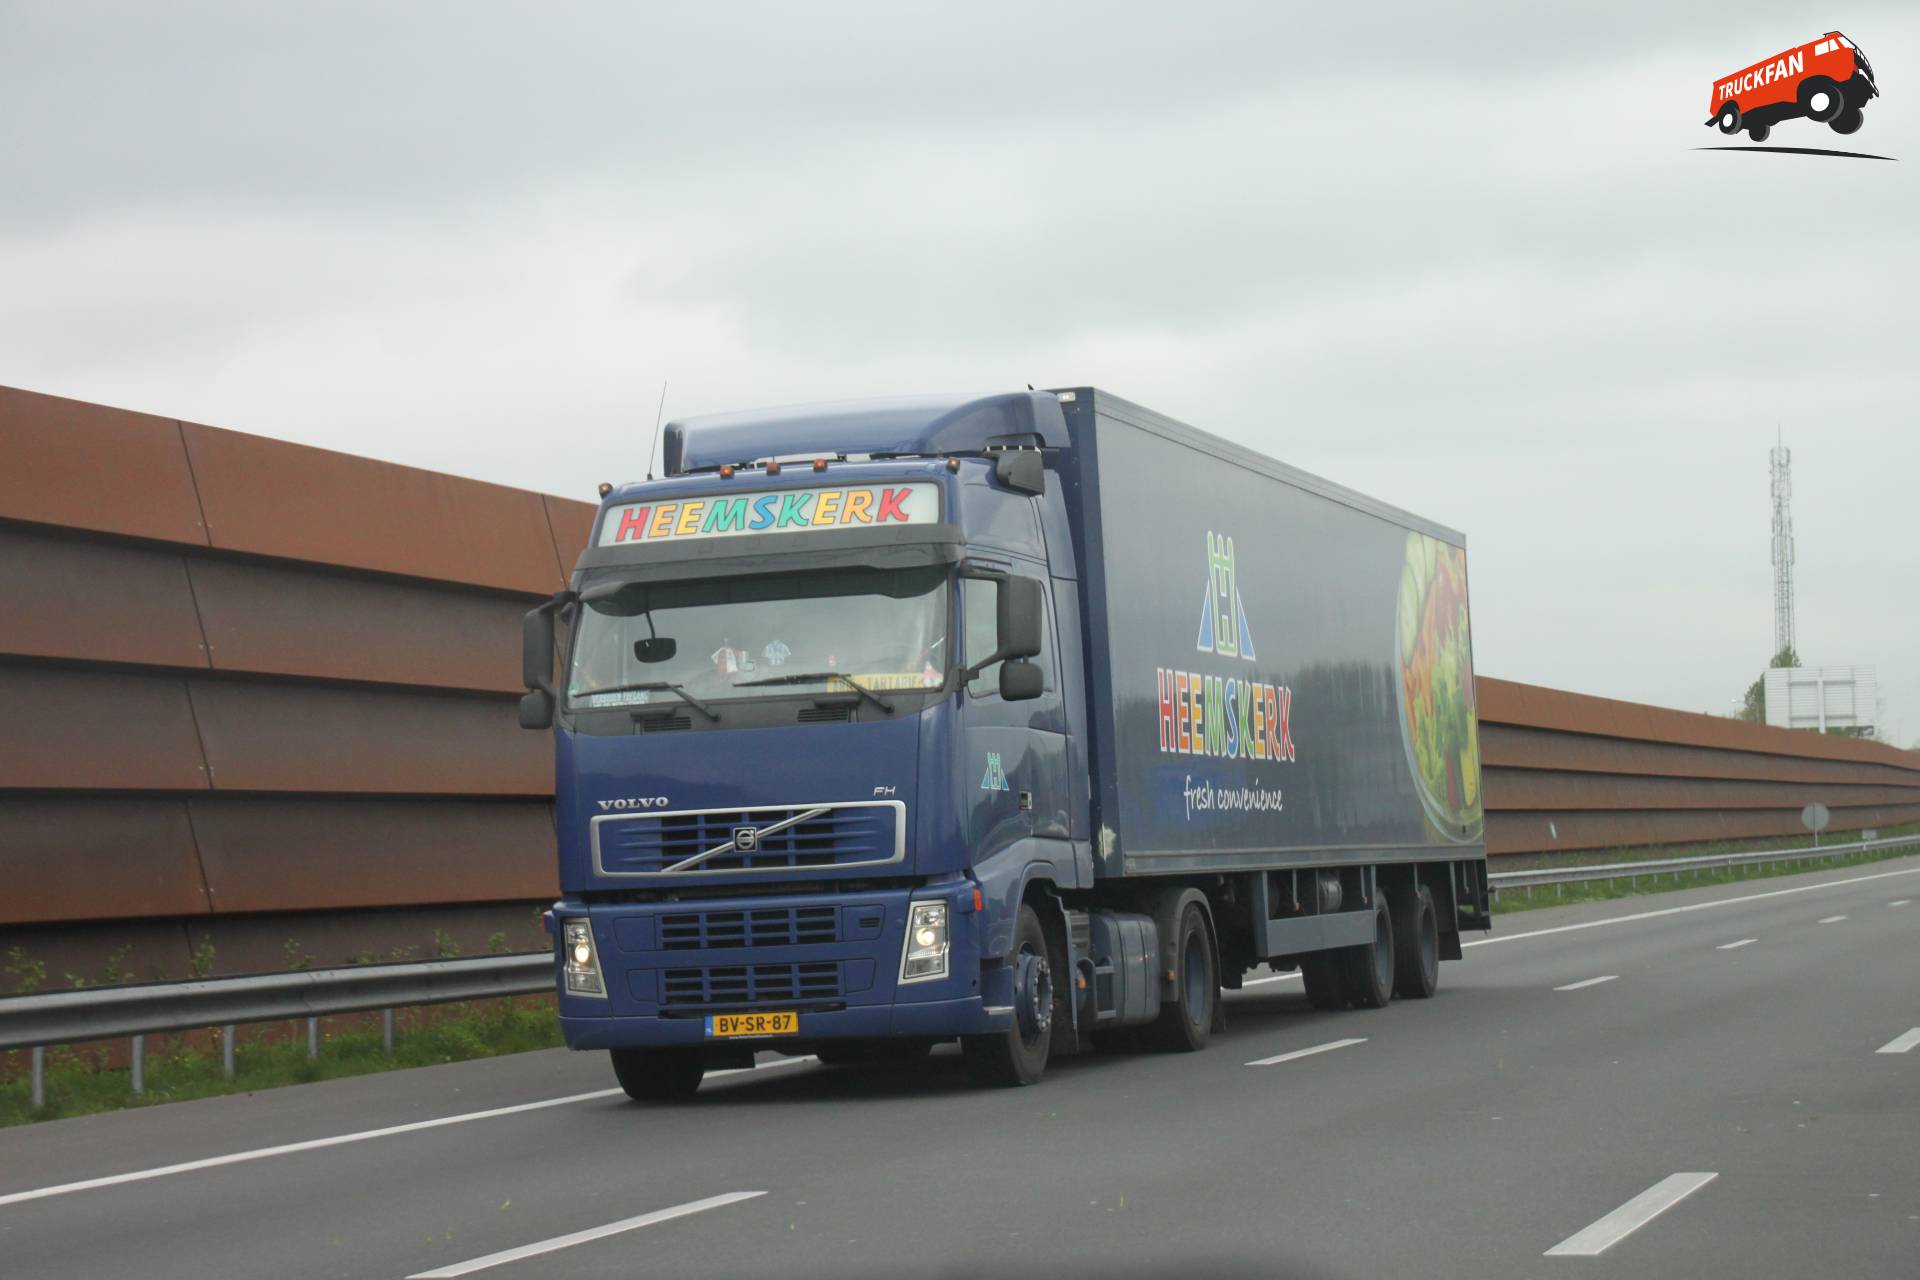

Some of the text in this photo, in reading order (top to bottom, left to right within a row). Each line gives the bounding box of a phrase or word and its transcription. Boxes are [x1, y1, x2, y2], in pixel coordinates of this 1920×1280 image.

[615, 488, 912, 542] HEEMSKERK
[1157, 667, 1295, 762] HEEMSKERK
[597, 797, 669, 810] VOLVO
[873, 786, 896, 796] FH
[1184, 775, 1283, 821] fresh convenience
[719, 1015, 791, 1032] BV-SR-87
